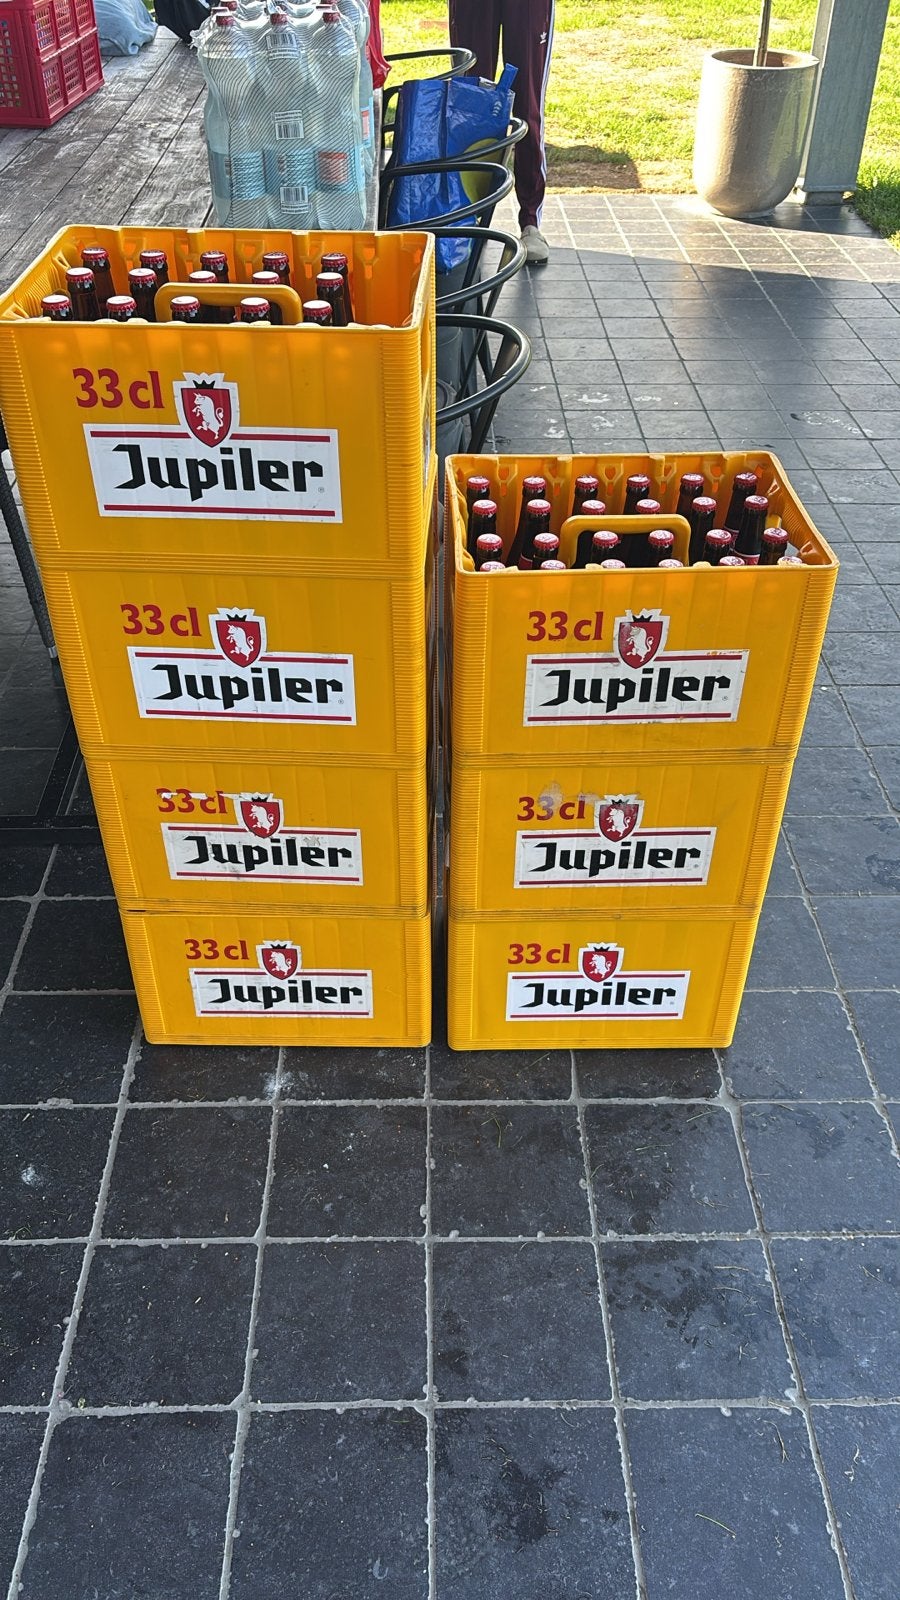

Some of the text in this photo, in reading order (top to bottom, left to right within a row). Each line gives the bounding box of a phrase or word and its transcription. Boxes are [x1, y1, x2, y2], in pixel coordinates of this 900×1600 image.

[112, 444, 325, 502] Jupiler
[151, 664, 343, 711] Jupiler
[538, 667, 731, 714] Jupiler
[182, 835, 352, 873] Jupiler
[528, 841, 702, 878] Jupiler
[208, 978, 363, 1010] Jupiler
[518, 981, 677, 1013] Jupiler
